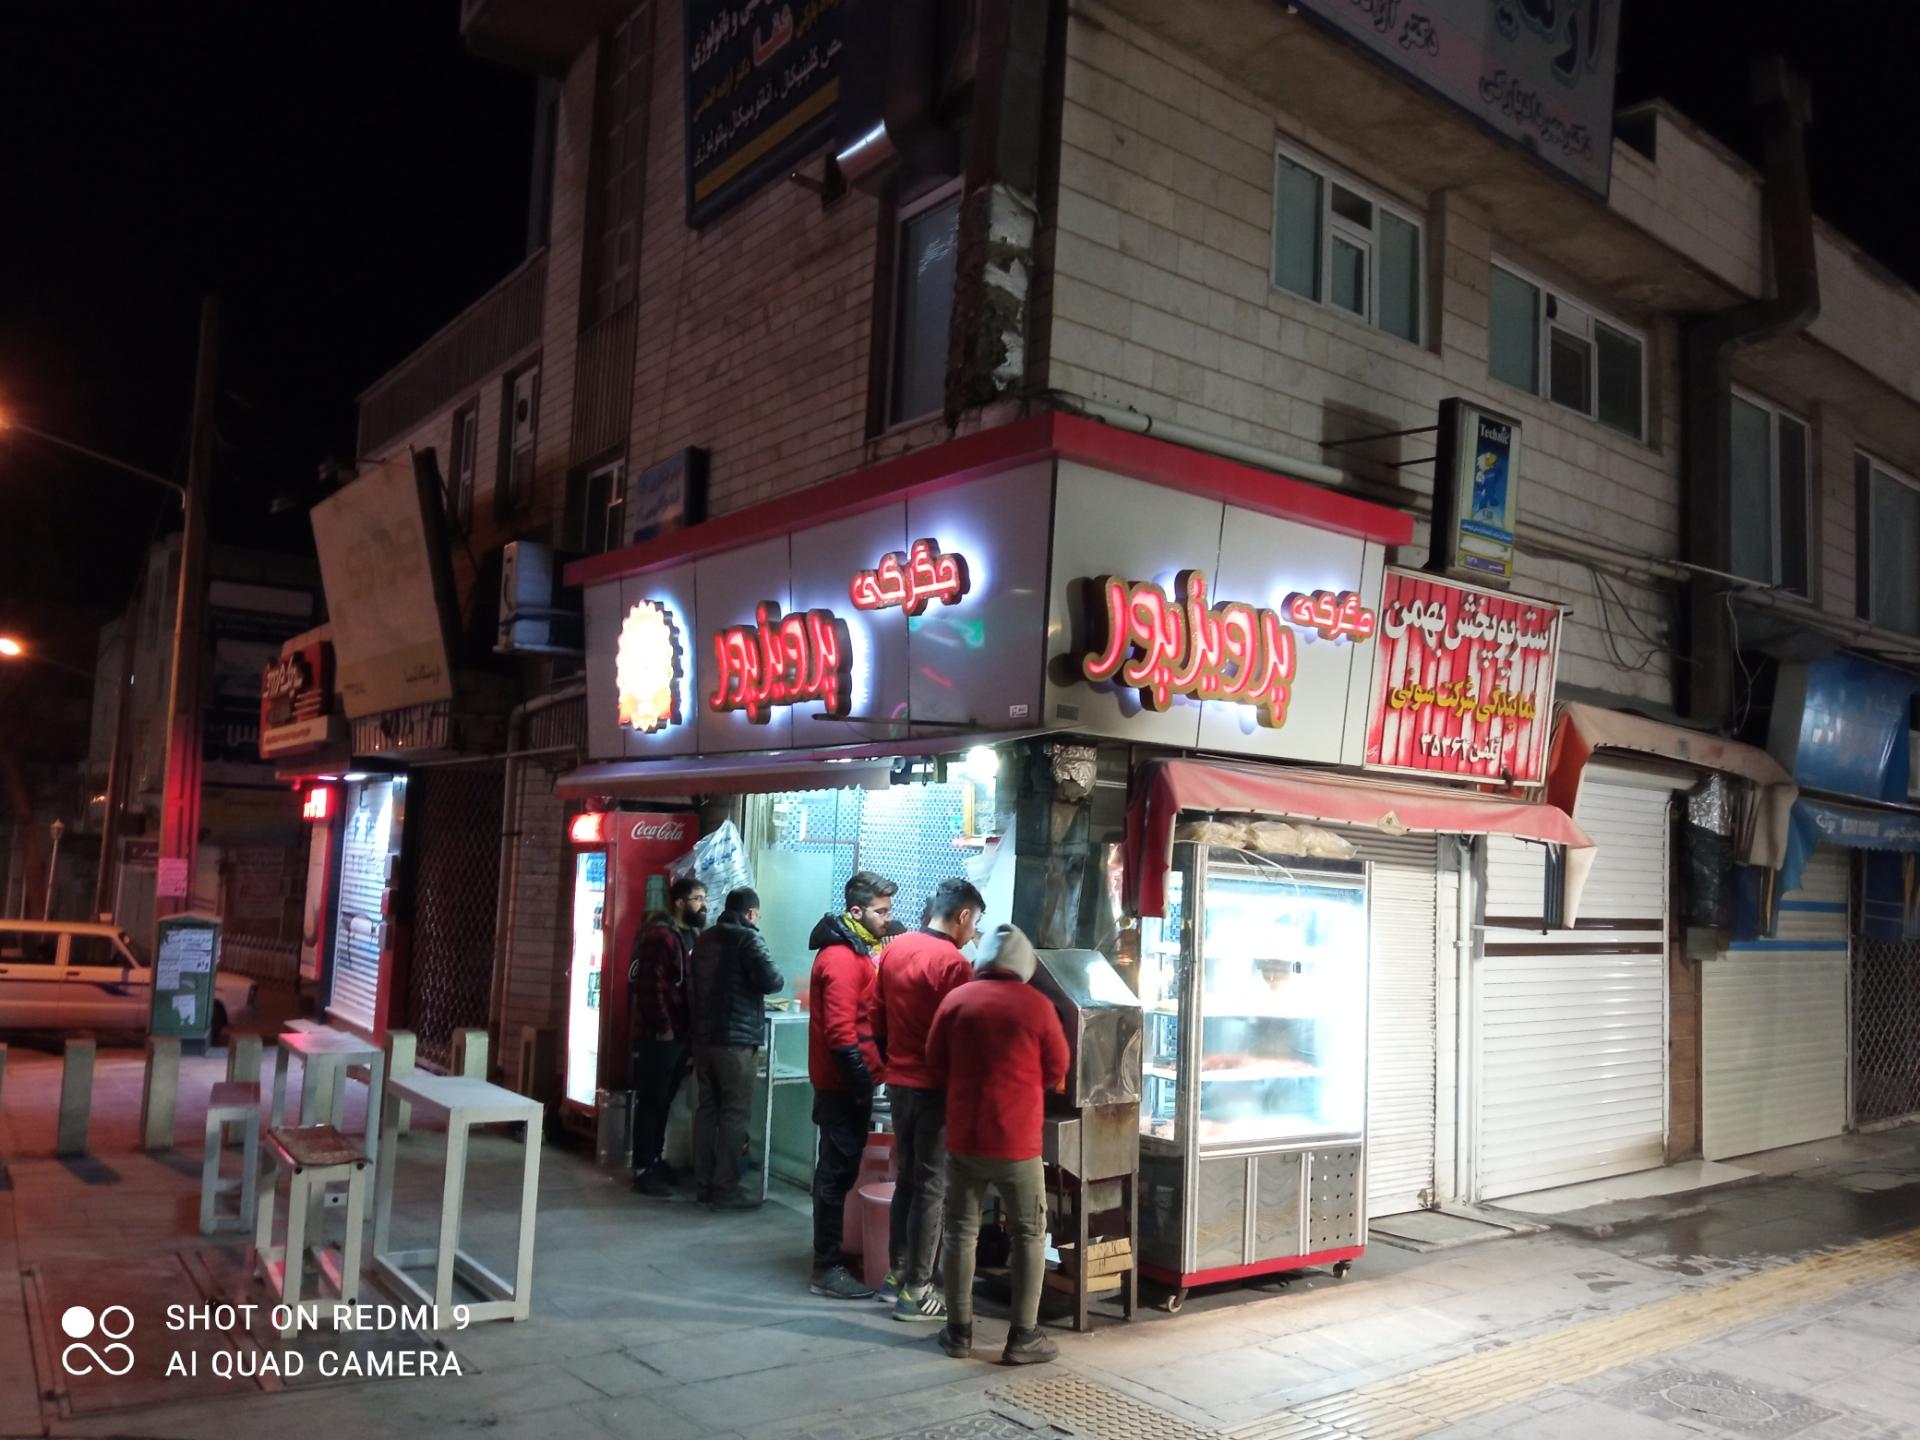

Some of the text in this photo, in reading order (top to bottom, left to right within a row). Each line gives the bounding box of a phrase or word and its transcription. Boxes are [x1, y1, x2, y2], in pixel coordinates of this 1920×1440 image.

[850, 538, 963, 614] جگرکی
[1384, 594, 1557, 677] استریو پخش بهمن
[1389, 667, 1537, 730] نمایندگی شرکت سونی
[1469, 736, 1502, 764] تلفن
[631, 820, 686, 841] Coca-Cola
